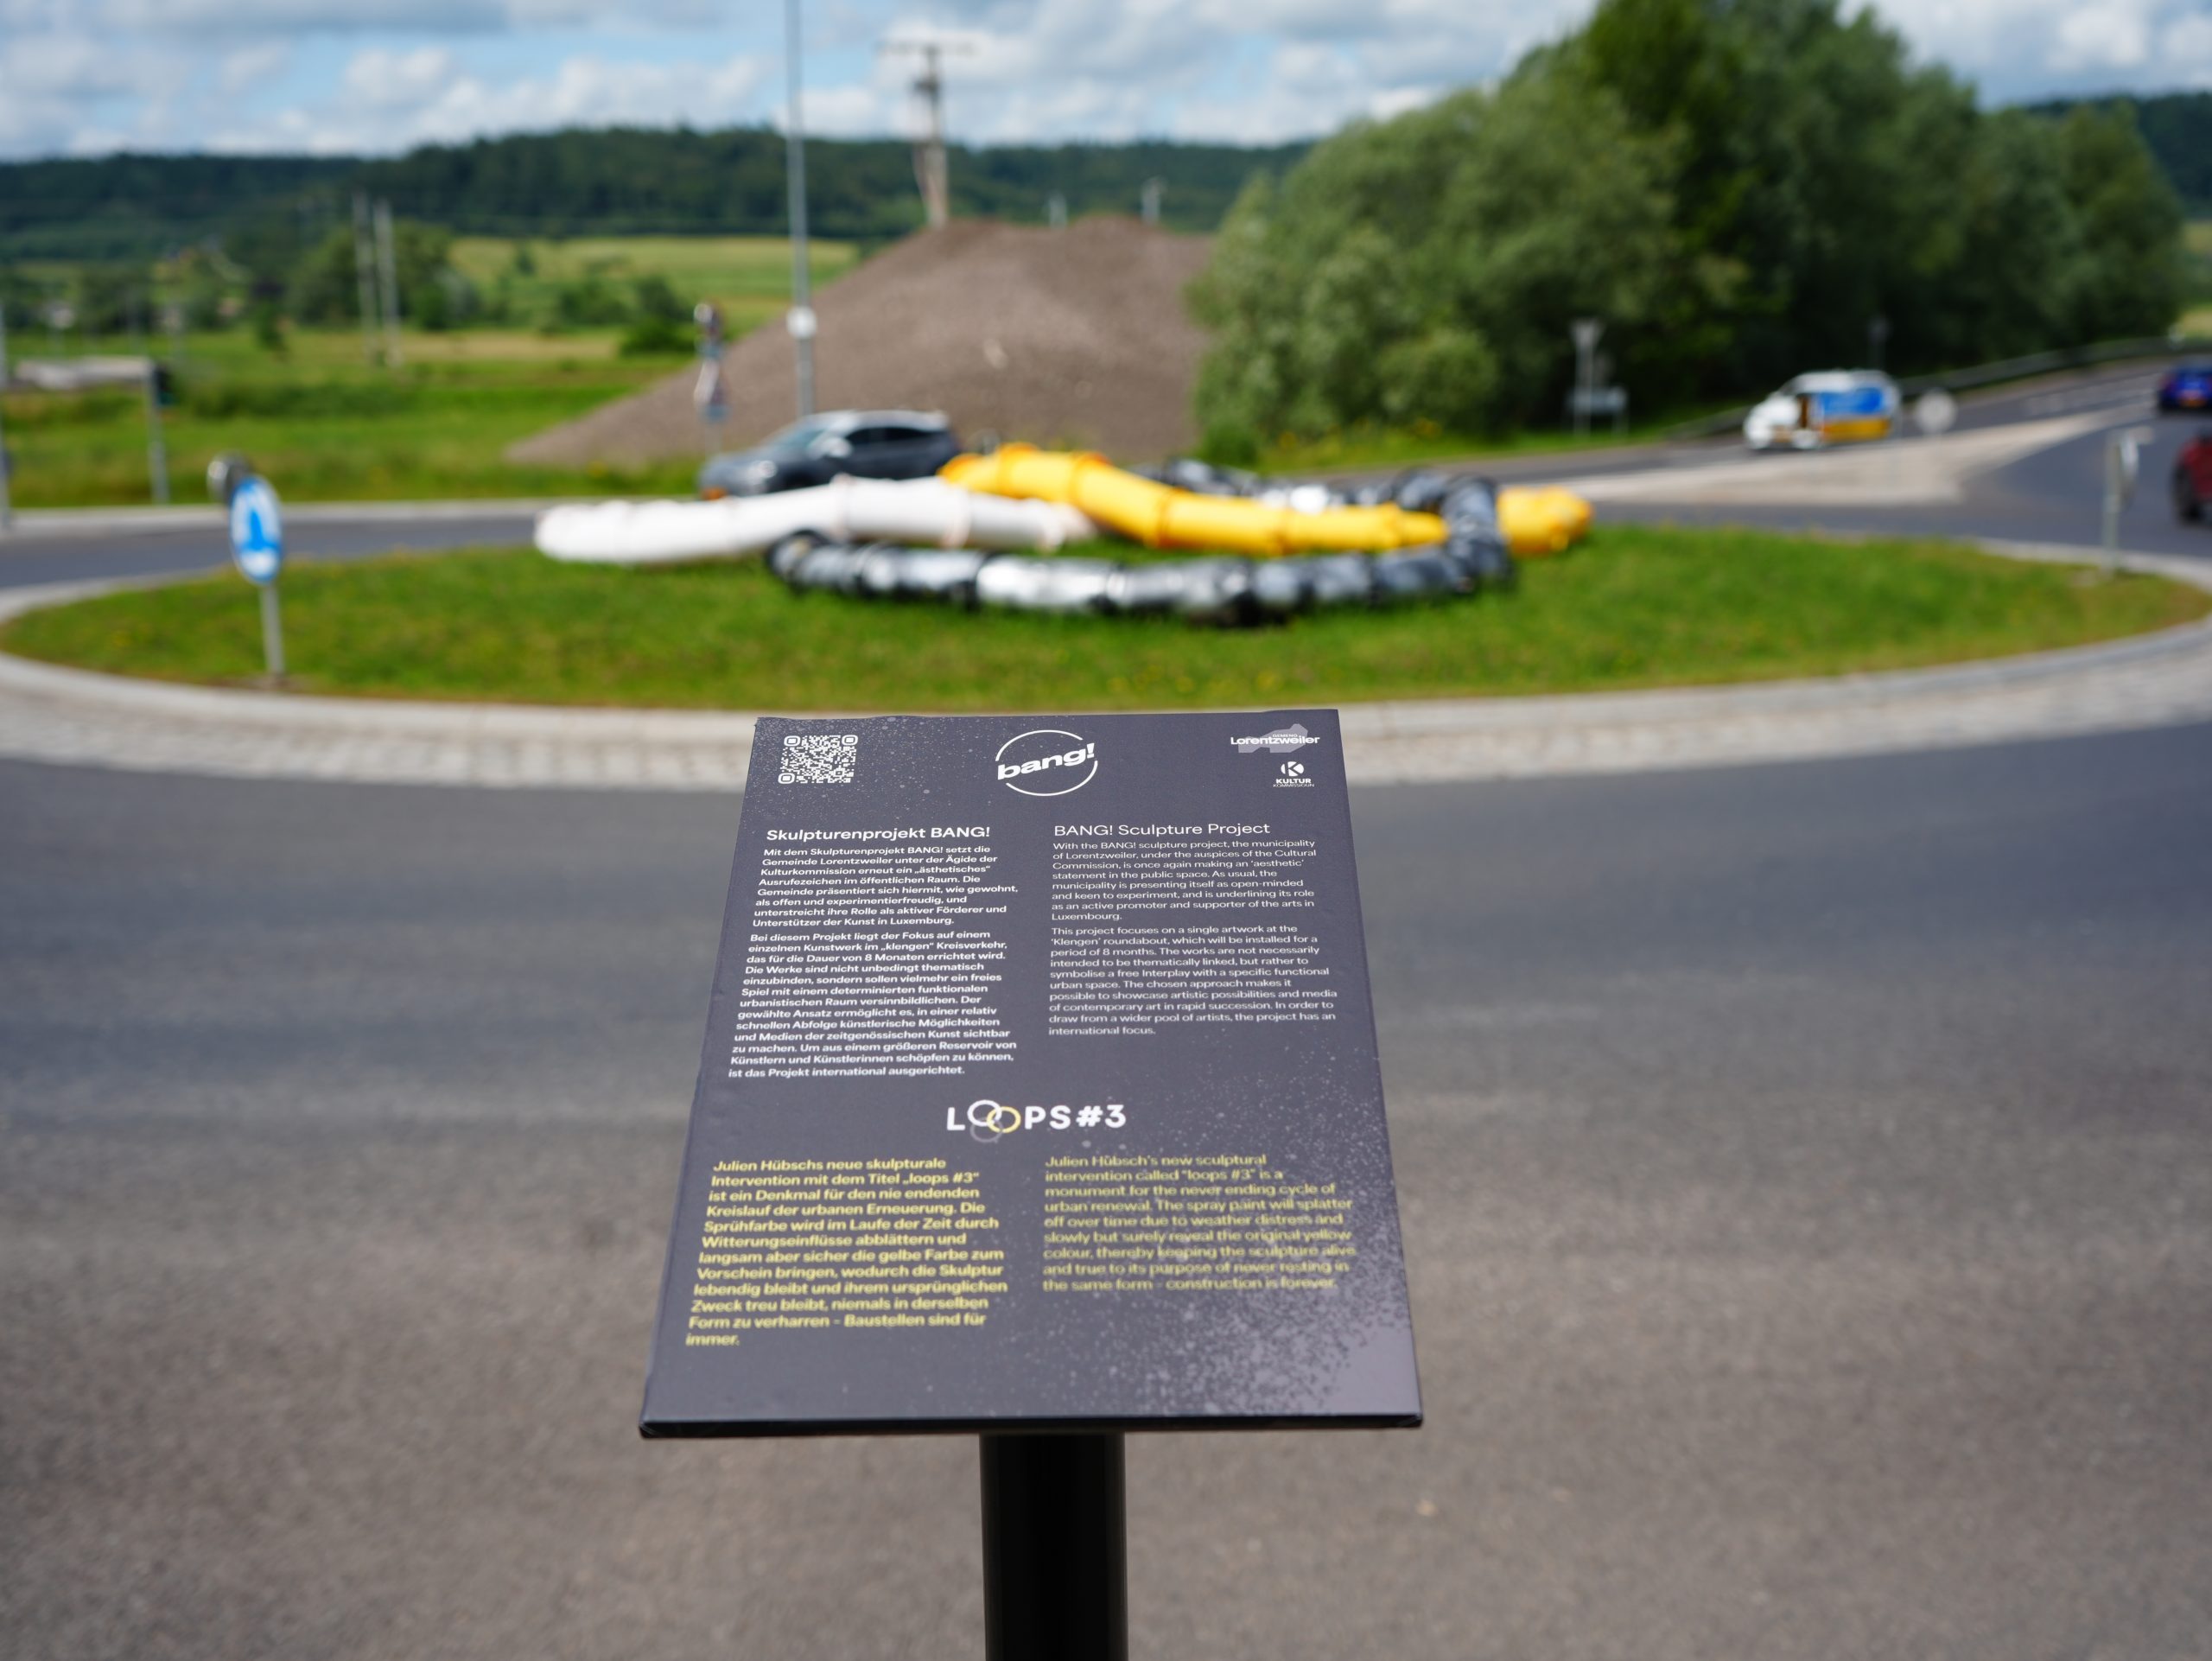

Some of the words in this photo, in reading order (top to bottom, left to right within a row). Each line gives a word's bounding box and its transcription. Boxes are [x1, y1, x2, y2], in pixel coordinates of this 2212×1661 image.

[1230, 735, 1320, 745] Lorentzweiler
[997, 742, 1095, 780] bang!
[766, 827, 926, 843] Skulpturenprojekt
[931, 826, 990, 837] BANG!
[1054, 824, 1112, 836] BANG!
[1118, 824, 1202, 837] Sculpture
[1208, 823, 1270, 837] Project
[1252, 839, 1315, 848] municipality
[810, 847, 905, 856] Skulpturenprojekt
[820, 856, 893, 865] Lorentzweiler
[945, 855, 976, 864] Ägide
[1194, 860, 1232, 869] making
[1141, 871, 1173, 880] public
[1052, 881, 1116, 890] municipality
[1129, 881, 1186, 889] presenting
[1230, 879, 1304, 888] open-minded
[816, 887, 875, 896] präsentiert
[967, 885, 1018, 894] gewohnt,
[1116, 891, 1179, 900] experiment,
[826, 896, 944, 906] experimentierfreudig,
[890, 917, 954, 926] Luxemburg.
[1076, 927, 1114, 936] project
[1187, 926, 1219, 934] single
[812, 932, 851, 942] Projekt
[854, 932, 879, 941] liegt
[715, 1161, 758, 1171] Julien
[760, 1160, 824, 1170] Hübschs
[825, 1161, 864, 1170] neue
[866, 1158, 946, 1171] skulpturale
[1046, 1157, 1089, 1167] Julien
[1195, 1155, 1267, 1166] sculptural
[1045, 1187, 1126, 1196] monument
[1129, 1186, 1150, 1195] for
[1151, 1186, 1176, 1195] the
[1180, 1187, 1220, 1195] never
[1224, 1184, 1276, 1197] ending
[1278, 1184, 1319, 1195] cycle
[1320, 1183, 1335, 1193] of
[707, 1205, 772, 1217] Kreislauf
[773, 1206, 798, 1216] der
[802, 1205, 864, 1216] urbanen
[960, 1201, 985, 1213] Die
